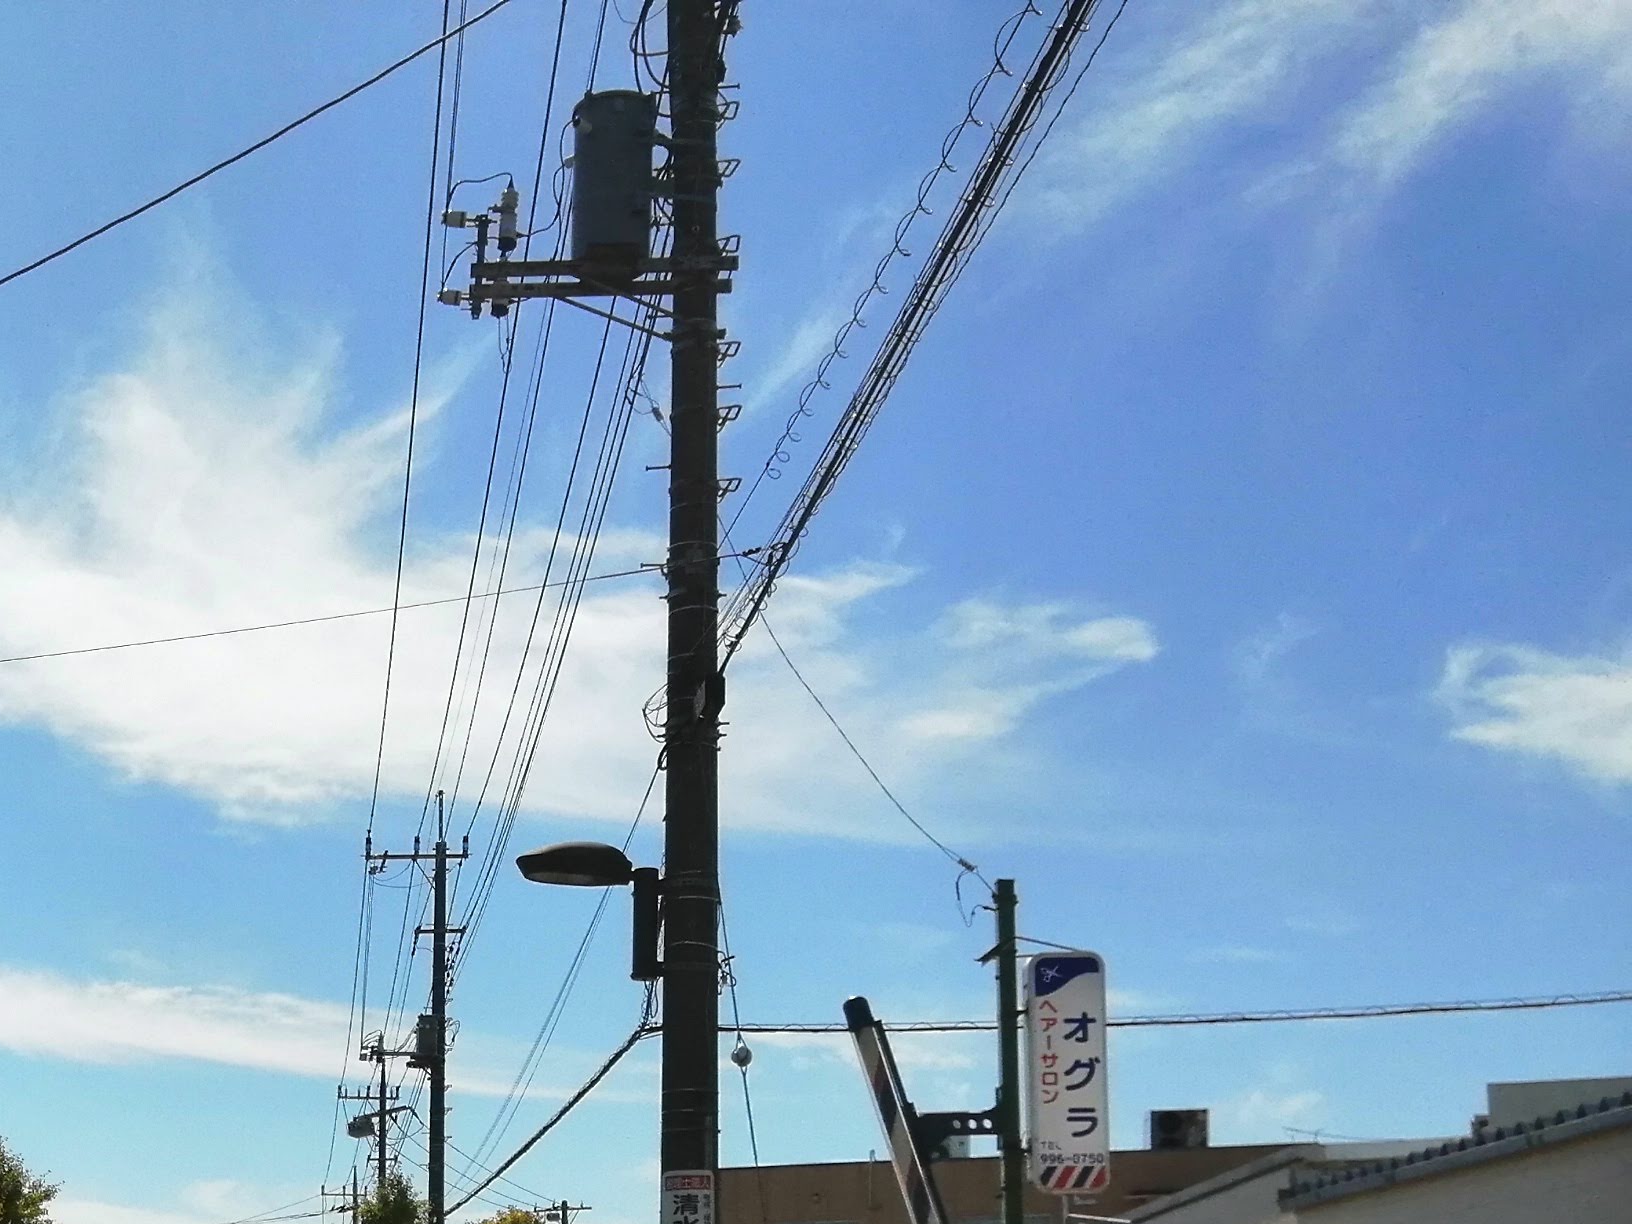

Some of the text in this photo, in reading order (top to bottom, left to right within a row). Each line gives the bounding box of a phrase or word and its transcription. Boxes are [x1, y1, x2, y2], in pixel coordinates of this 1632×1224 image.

[1039, 1000, 1059, 1105] ヘアーサロン
[1063, 1012, 1100, 1138] オグラ
[1040, 1141, 1062, 1151] TEL
